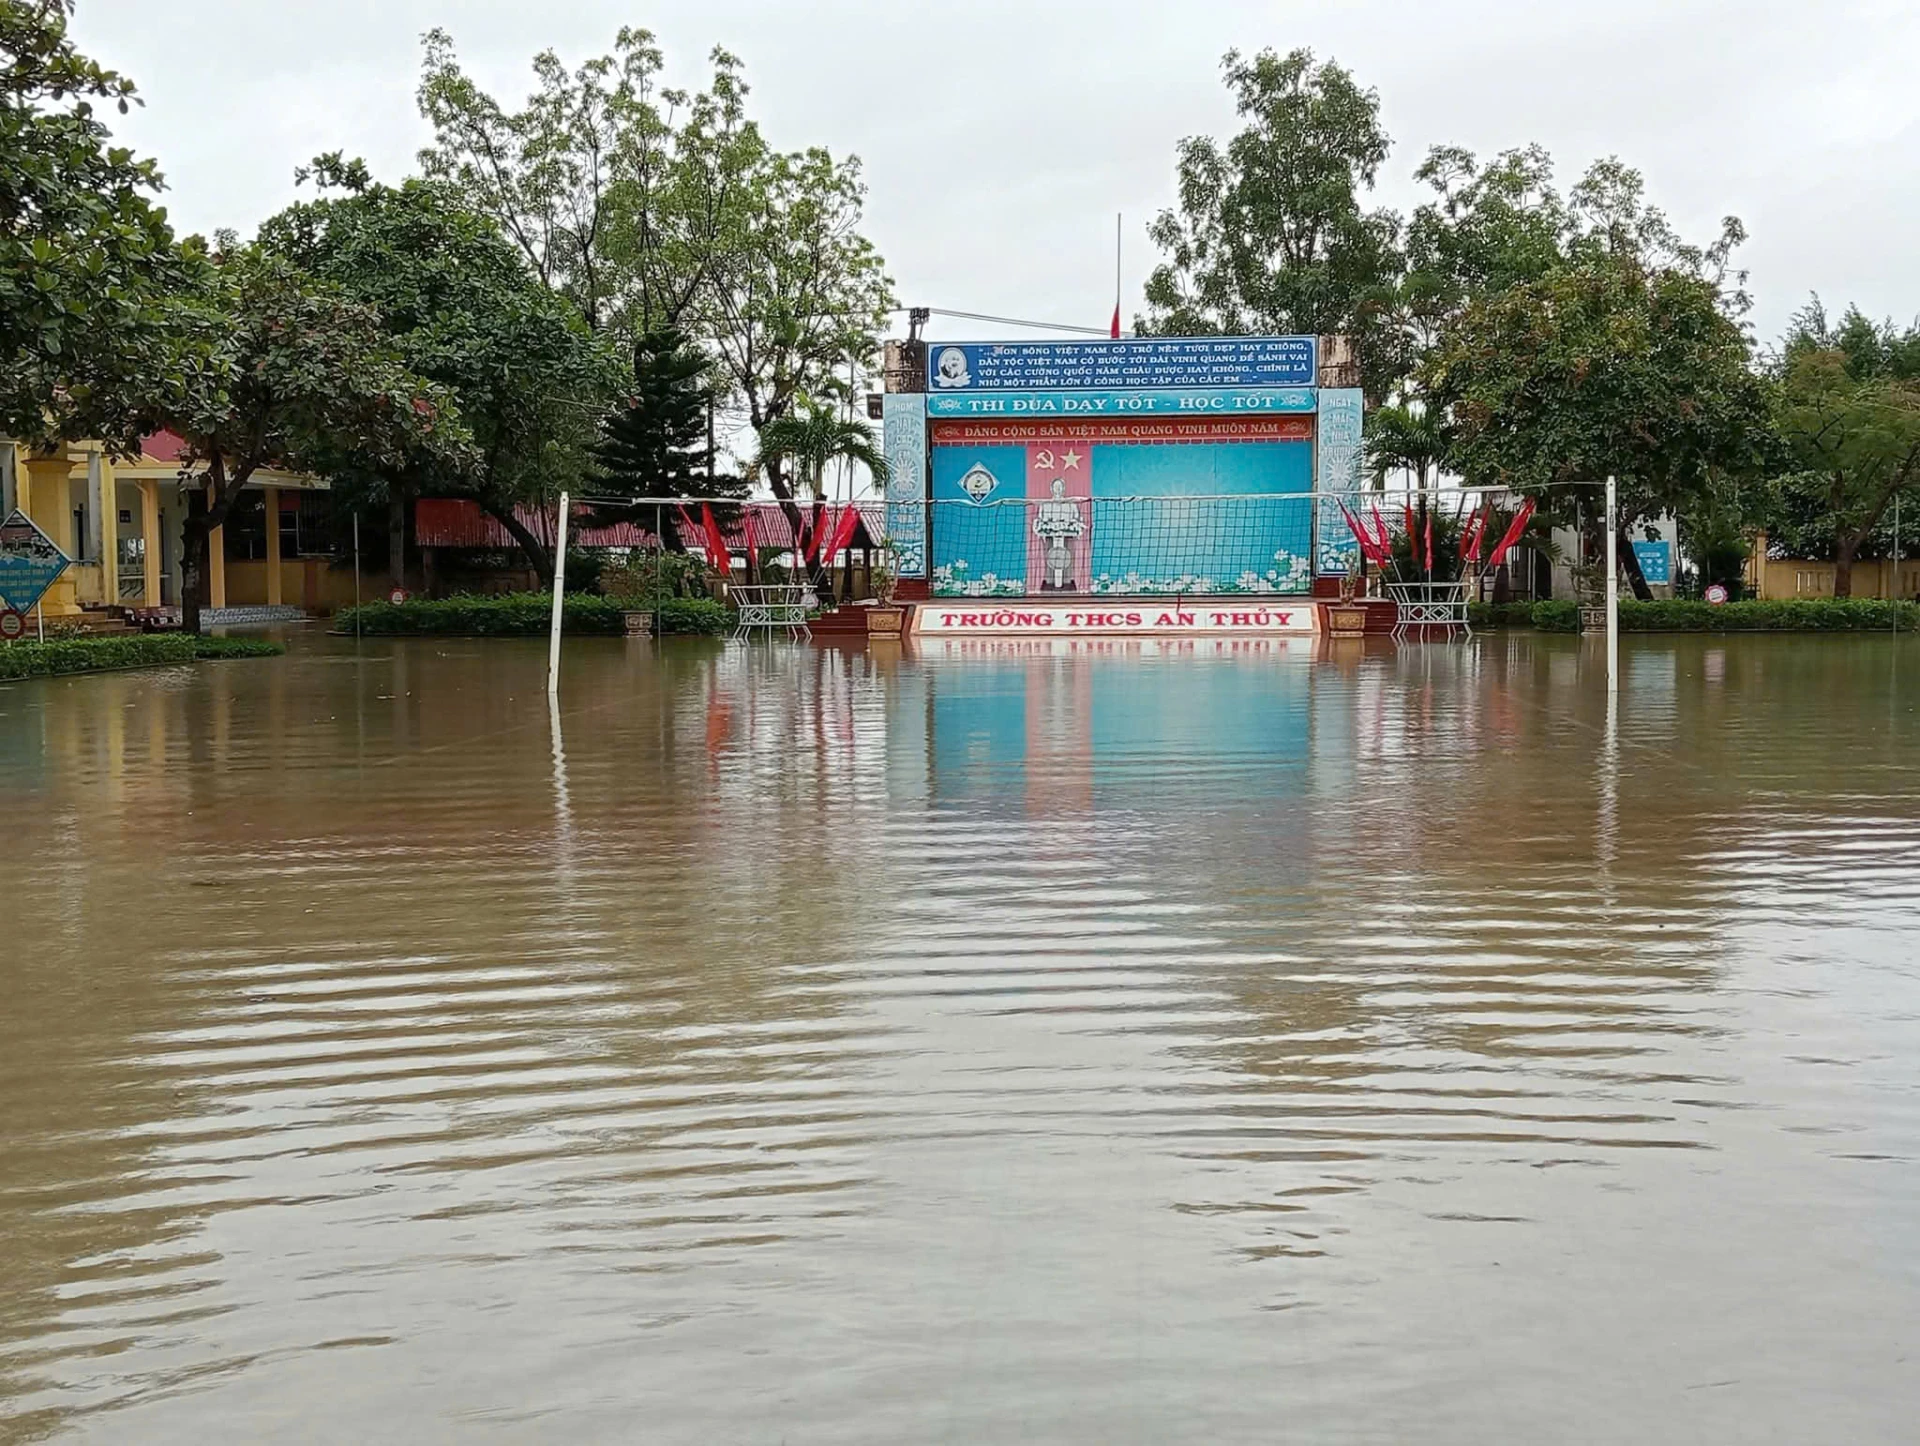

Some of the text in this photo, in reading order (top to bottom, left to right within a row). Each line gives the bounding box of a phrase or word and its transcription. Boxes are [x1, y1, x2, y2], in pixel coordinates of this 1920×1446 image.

[1084, 346, 1107, 354] NAM
[1003, 357, 1024, 366] TỘC
[1055, 357, 1077, 365] NAM
[1171, 355, 1198, 363] VINH
[1200, 354, 1236, 363] QUANG
[1290, 353, 1307, 361] VAI
[1187, 366, 1209, 374] HAY
[1004, 378, 1027, 387] MỘT
[1094, 377, 1123, 385] CÔNG
[1126, 377, 1148, 386] HỌC
[968, 400, 1005, 411] THI
[1013, 399, 1057, 411] ĐUA
[1064, 398, 1107, 413] DẠY
[1114, 394, 1157, 410] TỐT
[1179, 397, 1225, 411] HỌC
[1232, 392, 1275, 408] TỐT
[965, 423, 1279, 438] ĐẢNG CỘNG SẢN VIỆT NAM QUANG VINH MUÔN NĂM
[940, 607, 1294, 627] TRƯỜNG THCS AN THỦY
